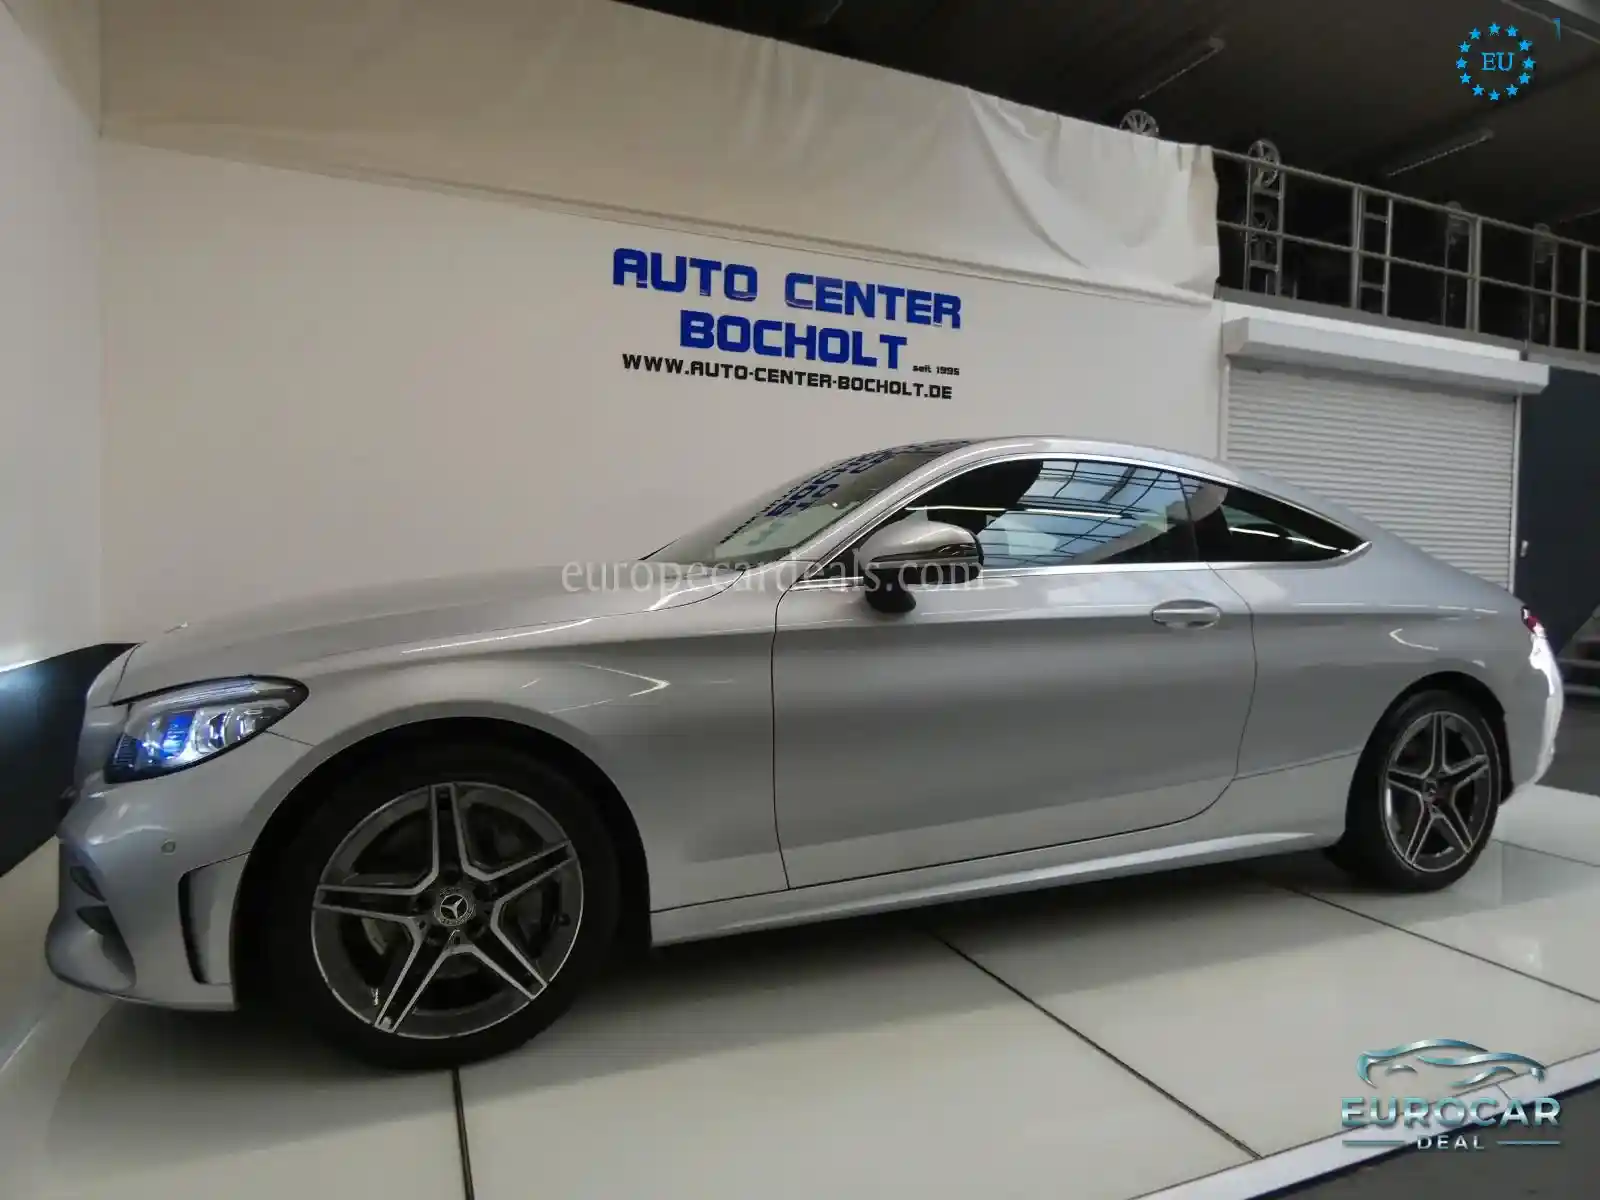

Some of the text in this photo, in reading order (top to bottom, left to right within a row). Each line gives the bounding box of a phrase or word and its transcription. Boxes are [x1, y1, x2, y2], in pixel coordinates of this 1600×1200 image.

[613, 248, 961, 329] AUTO CENTER
[680, 309, 907, 369] BOCHOLT
[622, 353, 952, 400] WWW.AUTO-CENTER-BOCHOLT.DE
